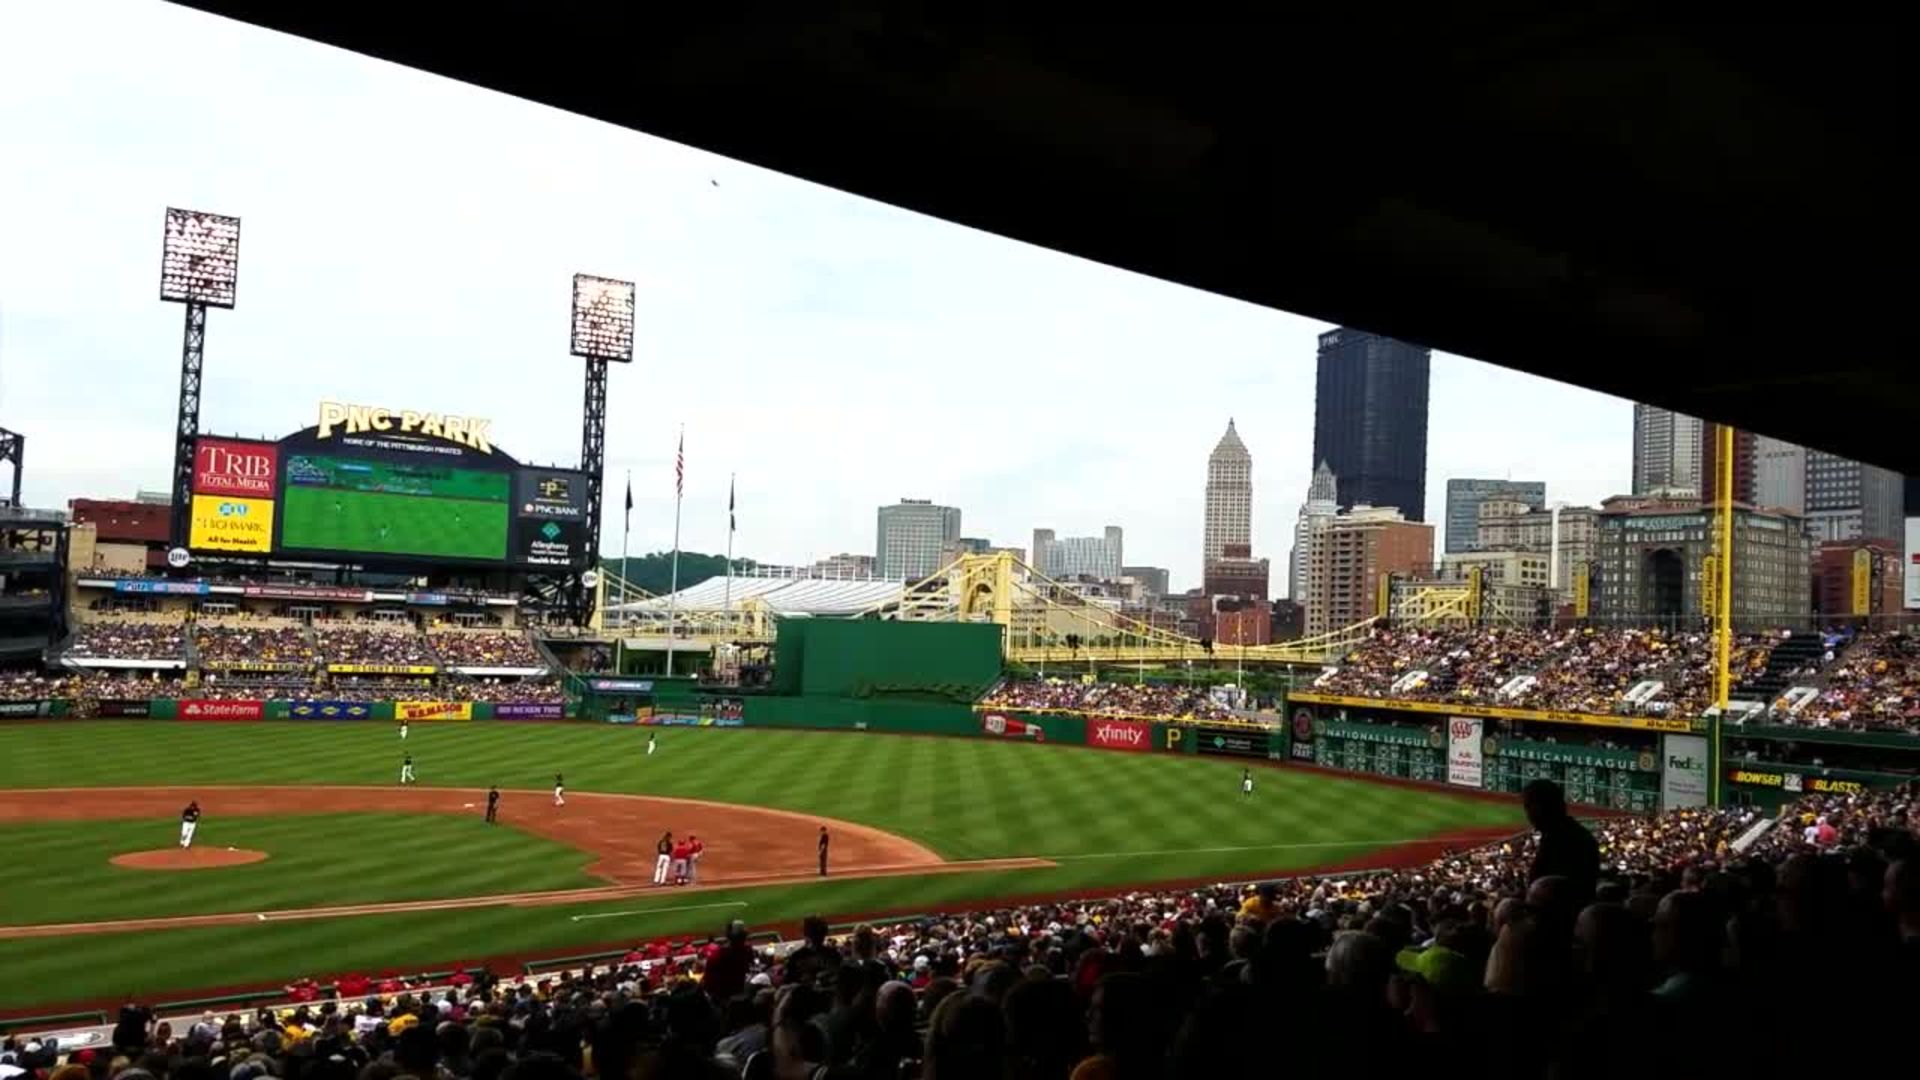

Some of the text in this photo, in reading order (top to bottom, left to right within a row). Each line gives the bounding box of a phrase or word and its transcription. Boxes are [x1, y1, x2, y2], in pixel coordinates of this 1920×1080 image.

[317, 401, 493, 455] PNC PARK
[364, 439, 375, 447] OF
[377, 440, 389, 449] THE
[200, 446, 271, 477] TRIB
[202, 473, 269, 490] TOTAL MEDIA
[535, 504, 579, 516] PNC BANK
[232, 537, 257, 545] Health
[531, 540, 569, 551] Allegheny
[1096, 724, 1143, 745] xfinity
[1166, 728, 1181, 749] P
[1326, 729, 1428, 747] NATIONAL LEAGUE
[1499, 748, 1637, 771] AMERICAN LEAGUE
[1669, 755, 1705, 770] FedEx
[1737, 771, 1783, 785] BOWSER
[1814, 780, 1861, 793] BLASTS
